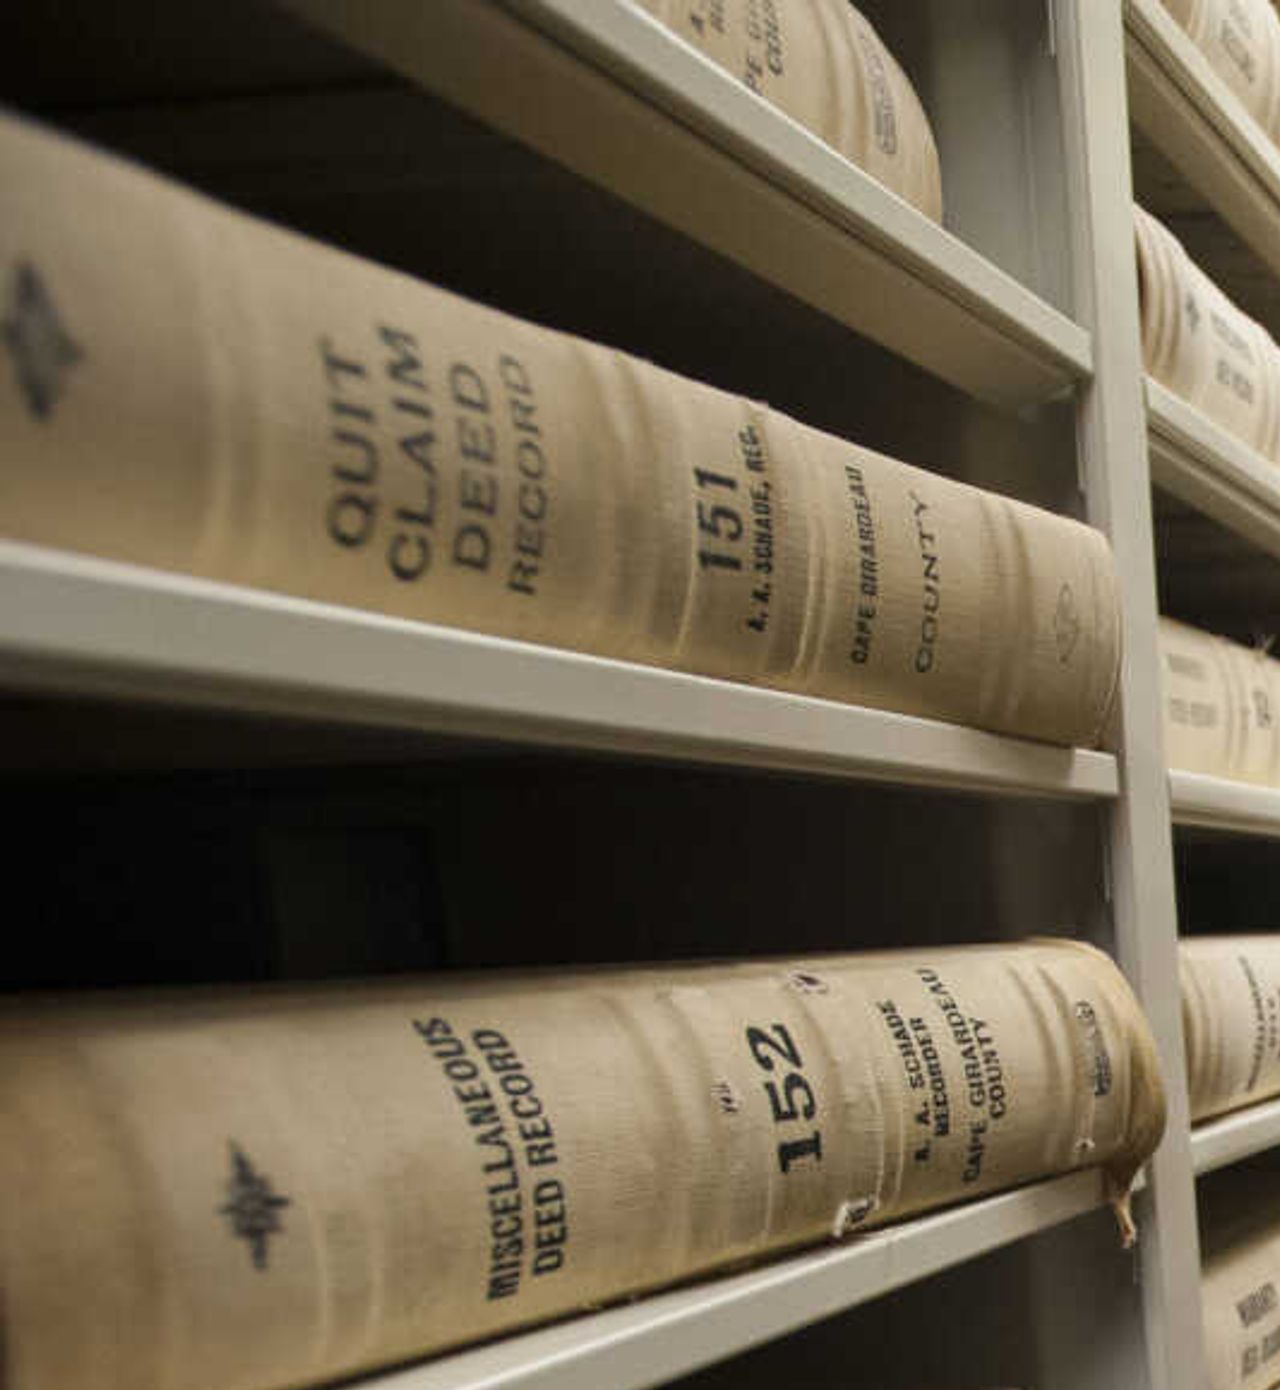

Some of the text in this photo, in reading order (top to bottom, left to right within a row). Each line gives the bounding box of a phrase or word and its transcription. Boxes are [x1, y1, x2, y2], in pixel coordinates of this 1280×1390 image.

[318, 332, 379, 550] QUIT
[378, 323, 437, 583] CLAIM
[449, 360, 498, 574] DEED
[499, 352, 549, 596] RECORD
[694, 465, 744, 572] 151
[844, 464, 880, 666] CAPE GIRARDEAU
[909, 487, 941, 674] COUNTY
[745, 1021, 823, 1175] 152
[876, 999, 927, 1089] SCHADE
[909, 1016, 950, 1139] RECORDER
[915, 966, 990, 1184] CAPE GIRARDEAU
[968, 1016, 1008, 1121] COUNTY
[412, 1015, 526, 1302] MISCELLANEOUS
[471, 1027, 568, 1278] DEED RECORD
